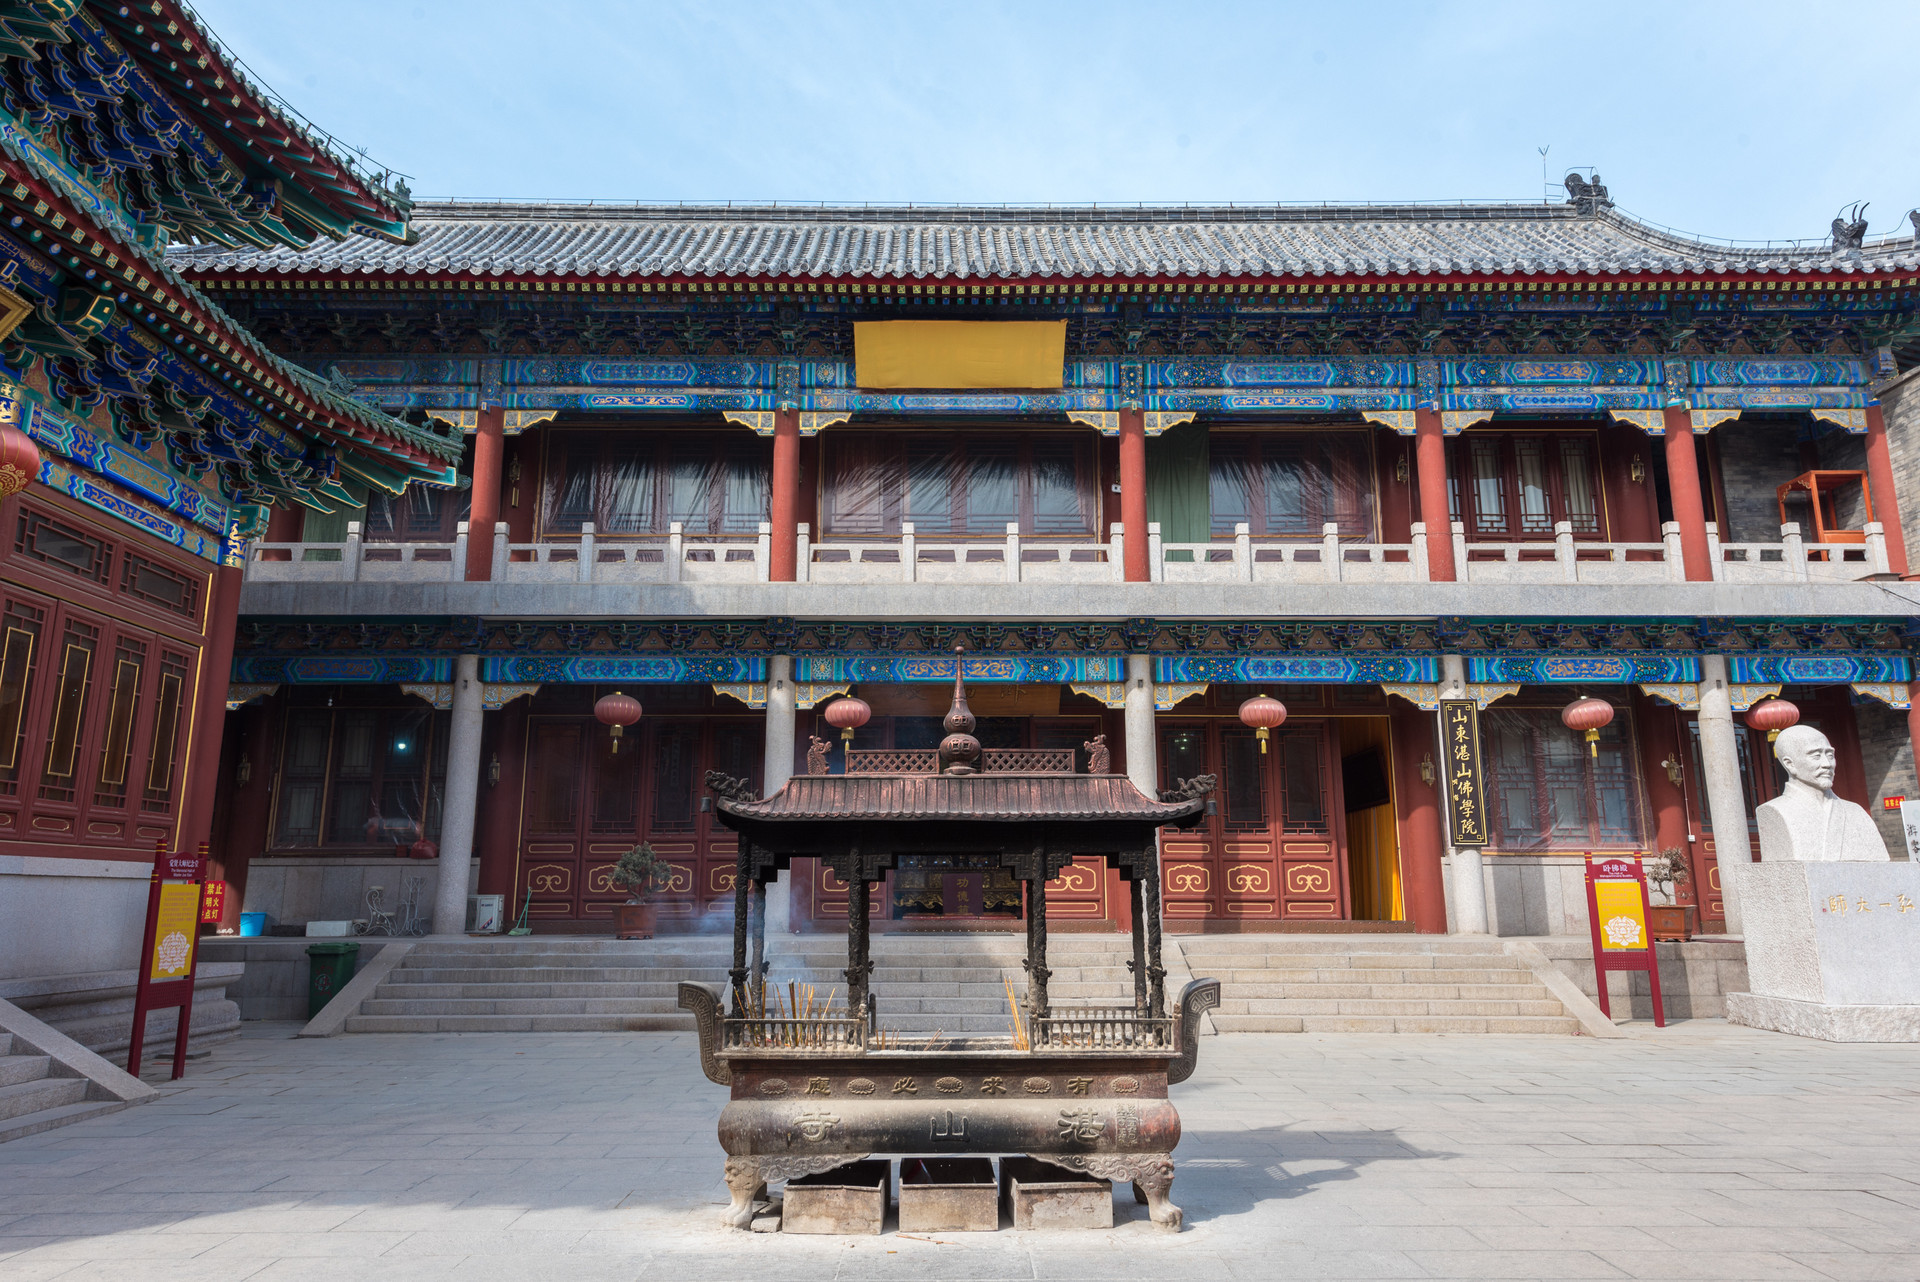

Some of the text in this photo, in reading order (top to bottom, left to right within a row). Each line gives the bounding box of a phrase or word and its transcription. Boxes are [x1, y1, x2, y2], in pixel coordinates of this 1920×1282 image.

[1452, 709, 1478, 835] 山東湛山佛學院
[206, 883, 223, 895] 禁止
[204, 897, 219, 907] 明火
[1828, 893, 1916, 917] 弘一大師
[202, 909, 219, 919] 点灯
[793, 1108, 1106, 1143] 湛山寺
